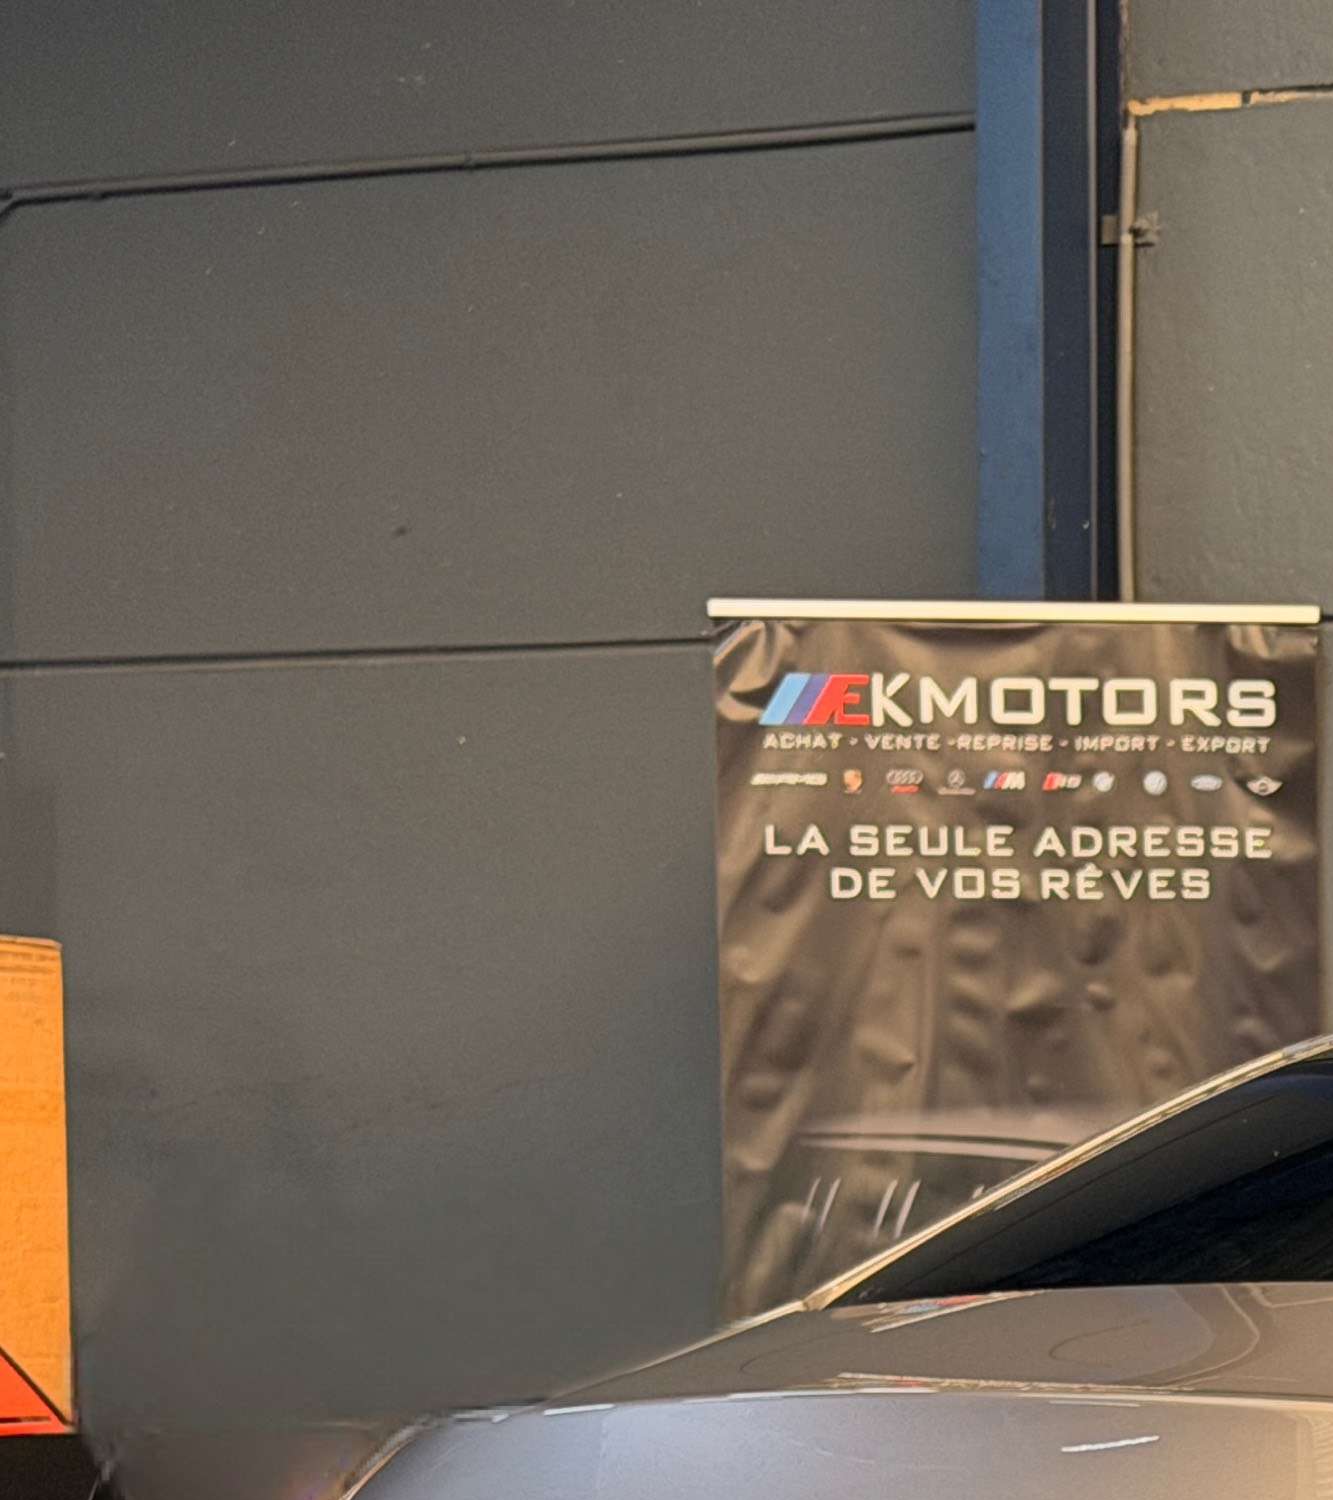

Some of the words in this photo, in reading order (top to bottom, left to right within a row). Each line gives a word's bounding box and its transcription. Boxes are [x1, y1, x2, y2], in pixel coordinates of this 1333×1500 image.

[762, 731, 843, 749] ACHAT
[864, 733, 941, 750] VENTE
[1074, 734, 1160, 752] IMPORT
[1180, 734, 1271, 754] EXPORT
[764, 823, 830, 856] LA
[849, 824, 1014, 857] SEULE
[1033, 825, 1273, 859] ADRESSE
[830, 867, 896, 899] DE
[915, 867, 1021, 899] VOS
[1040, 862, 1210, 900] RÊVES
